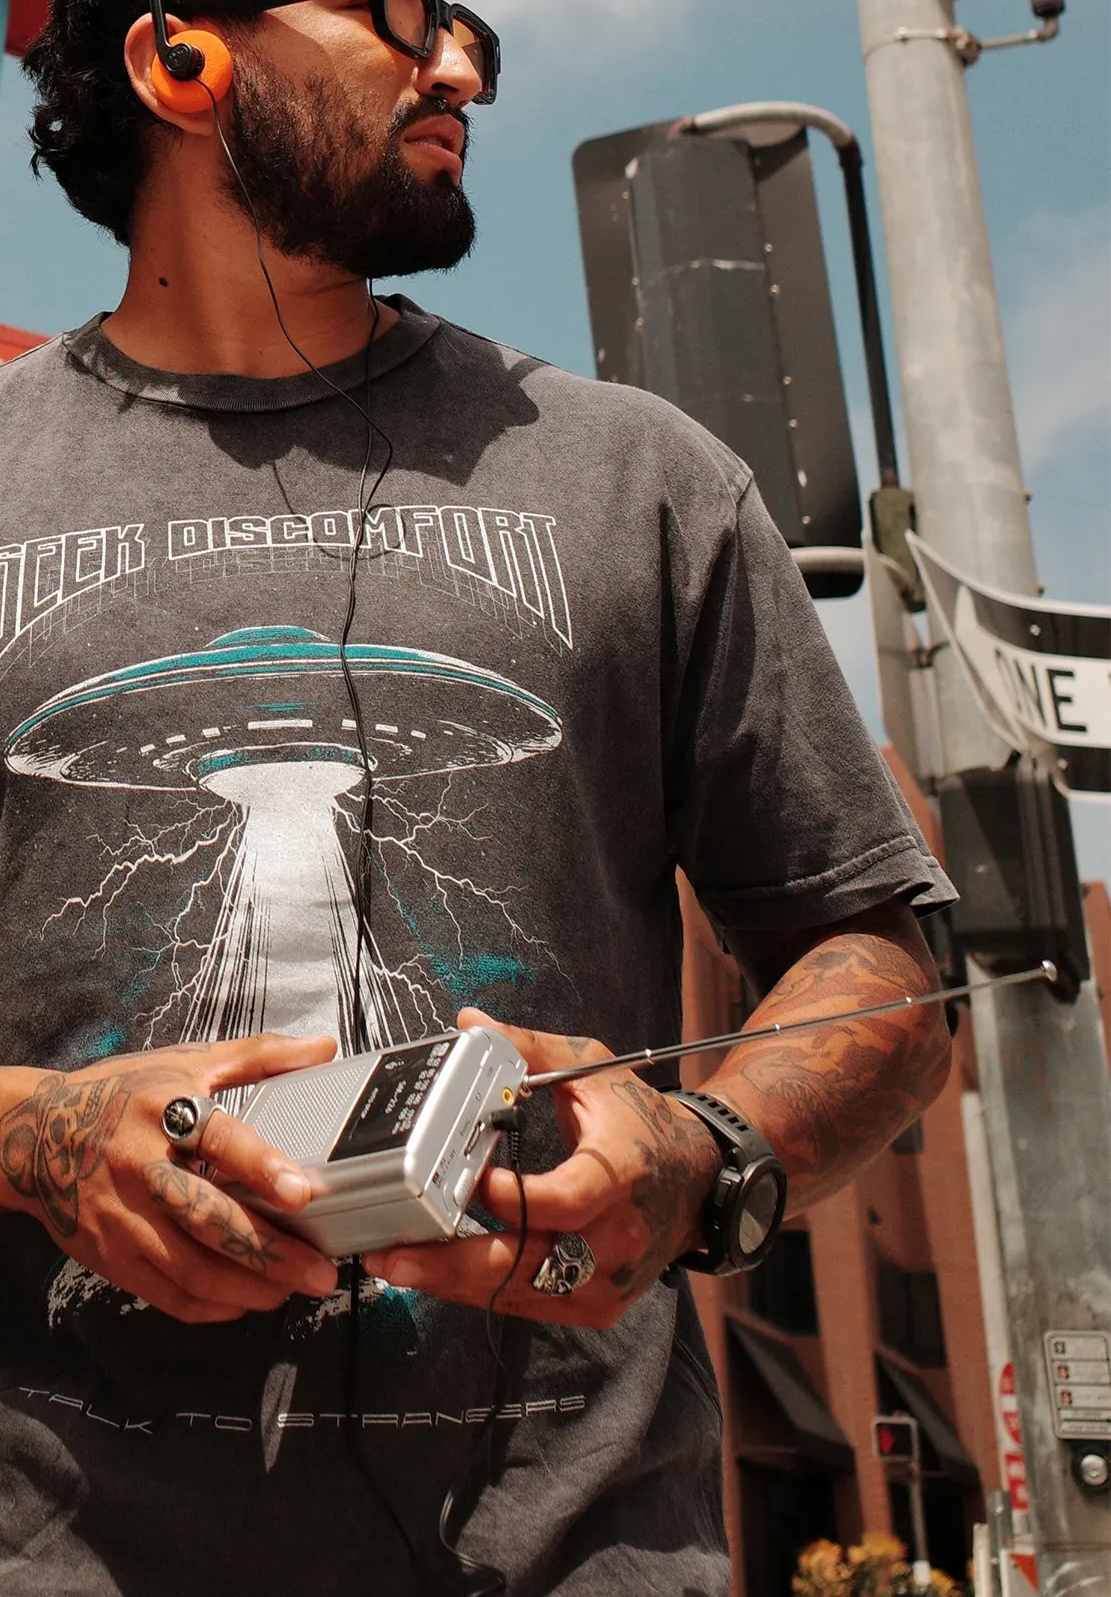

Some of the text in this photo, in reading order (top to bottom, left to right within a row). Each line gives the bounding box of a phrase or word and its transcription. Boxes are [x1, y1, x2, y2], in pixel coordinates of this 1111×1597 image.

[167, 504, 574, 650] DISCOMFORT
[19, 1386, 154, 1435] TALK
[175, 1412, 253, 1432] TO
